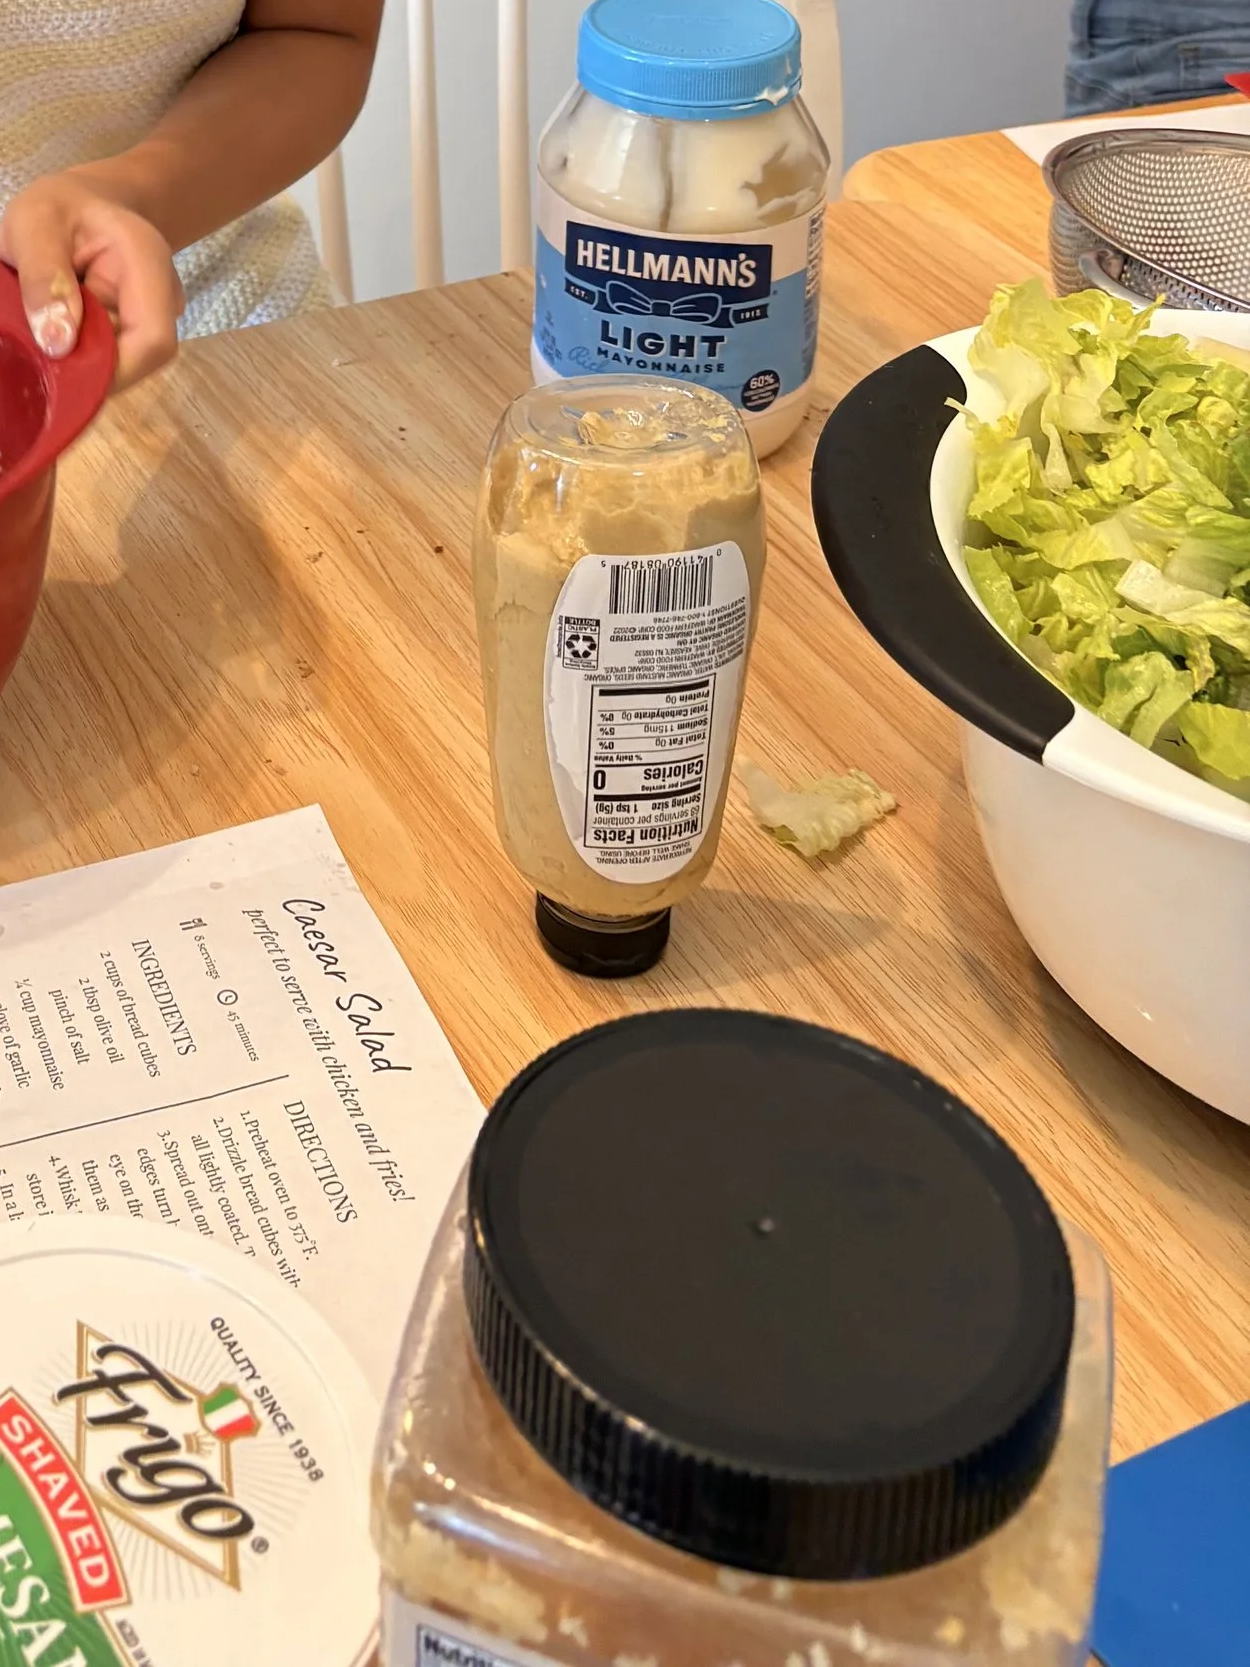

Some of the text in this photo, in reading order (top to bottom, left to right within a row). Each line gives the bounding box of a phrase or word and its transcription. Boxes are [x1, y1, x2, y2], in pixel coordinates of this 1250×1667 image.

[576, 239, 757, 289] HELLMANN'S
[600, 318, 727, 359] LIGHT
[596, 346, 726, 374] MAYONNAISE
[750, 373, 775, 390] 60%
[567, 624, 596, 632] PLASTIC
[600, 704, 708, 721] Total Carbohydrate 0g 0%
[666, 690, 709, 704] Protein 0g
[599, 732, 706, 750] Total Fat 0g 0%
[600, 718, 708, 735] Sodium 115mg 5%
[594, 760, 703, 790] Calories 0
[593, 817, 635, 825] container
[596, 794, 700, 814] Serving size 1 tsp (5g)
[637, 814, 651, 824] per
[654, 809, 688, 823] servings
[593, 817, 698, 844] Nutrition Facts
[192, 934, 221, 980] 8 servings
[18, 989, 37, 1014] cup
[130, 938, 197, 1056] INGREDIENTS
[280, 898, 413, 1074] Caesar Salad
[46, 988, 91, 1066] pinch of salt
[77, 976, 125, 1065] 2 tbsp olive oil
[98, 949, 161, 1078] 2 cups of bread cubes
[1, 1034, 21, 1050] of
[27, 1013, 65, 1091] mayonnaise
[225, 1009, 260, 1062] 45 minutes
[240, 908, 416, 1203] perfect to serve with chicken and fries!
[3, 1050, 32, 1089] garlic
[189, 1133, 211, 1152] all
[281, 1099, 358, 1224] DIRECTIONS
[24, 1172, 47, 1210] store
[80, 1158, 110, 1213] them as
[107, 1153, 126, 1179] eye
[117, 1178, 134, 1198] on
[135, 1147, 160, 1187] edges
[151, 1186, 173, 1219] turn
[197, 1150, 226, 1194] lightly
[4, 1200, 17, 1212] a
[182, 1188, 204, 1214] out
[237, 1172, 269, 1215] bread
[255, 1216, 283, 1257] cubes
[267, 1171, 291, 1205] oven
[282, 1204, 298, 1221] to
[192, 1213, 215, 1236] ont
[216, 1196, 250, 1246] coated.
[210, 1317, 324, 1482] QUALITY SINCE 1938
[55, 1343, 256, 1539] Frigo
[1, 1413, 111, 1589] SHAVED
